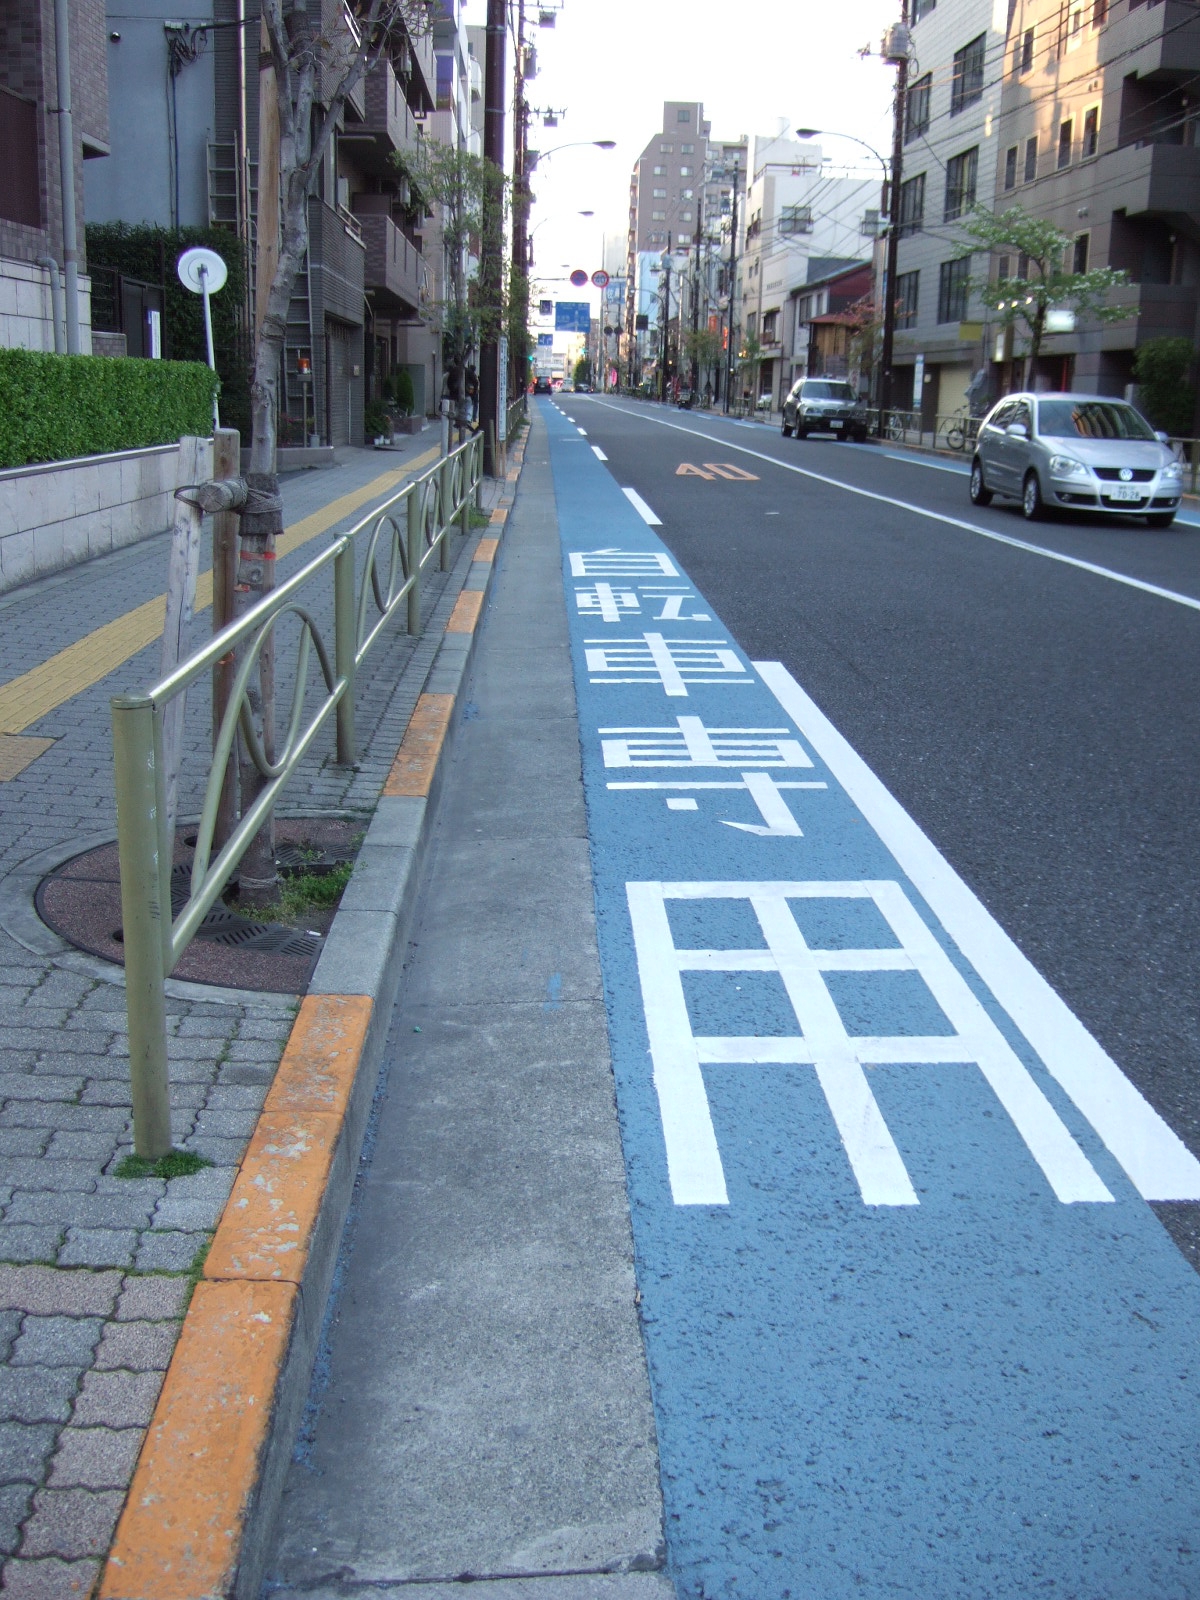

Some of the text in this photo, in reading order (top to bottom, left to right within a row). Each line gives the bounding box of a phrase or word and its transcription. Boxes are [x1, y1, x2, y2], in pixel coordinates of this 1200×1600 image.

[675, 463, 760, 480] 40
[568, 548, 1115, 1206] 自転車専用
